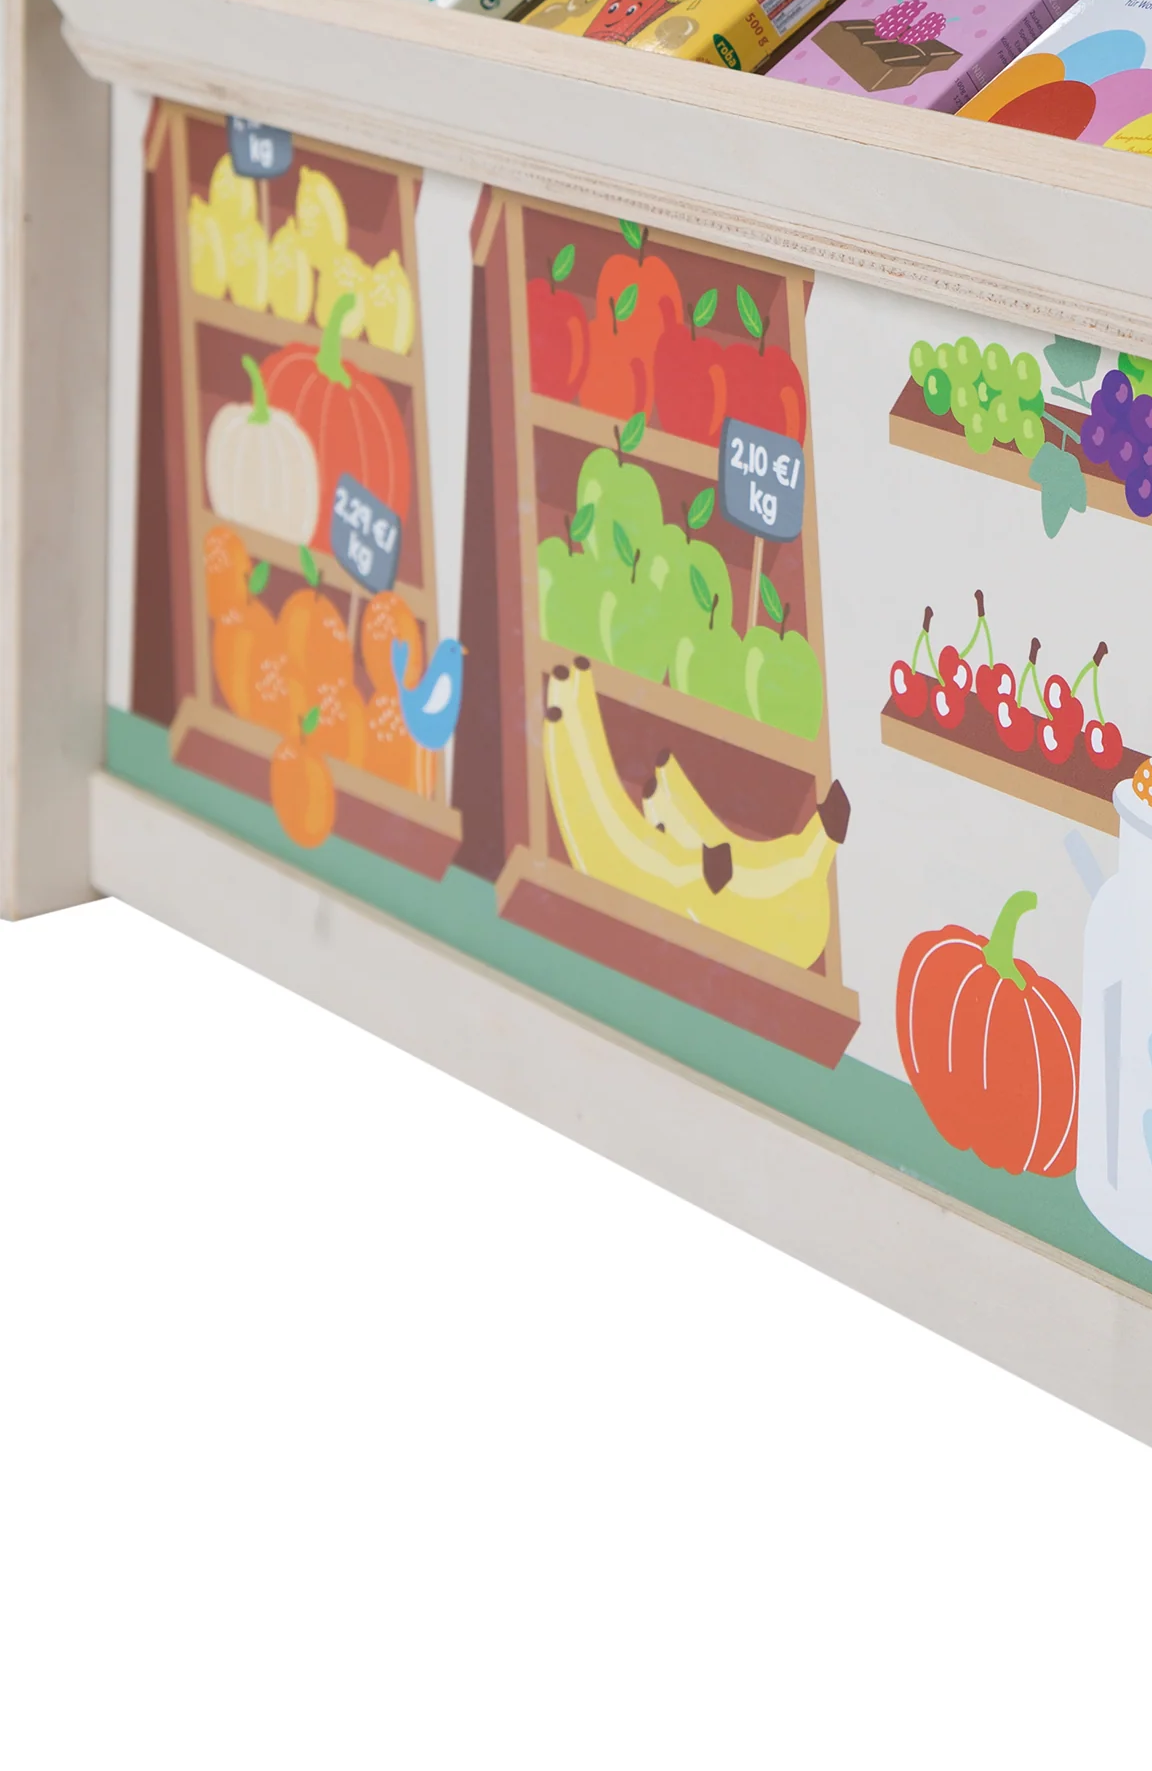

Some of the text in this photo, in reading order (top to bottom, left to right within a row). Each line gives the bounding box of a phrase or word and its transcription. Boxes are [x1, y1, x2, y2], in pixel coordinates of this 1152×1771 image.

[745, 12, 770, 47] 500 g
[716, 41, 738, 68] roba
[249, 133, 274, 168] kg
[730, 437, 800, 489] 2,10 €/
[749, 480, 777, 526] kg
[348, 530, 373, 576] kg
